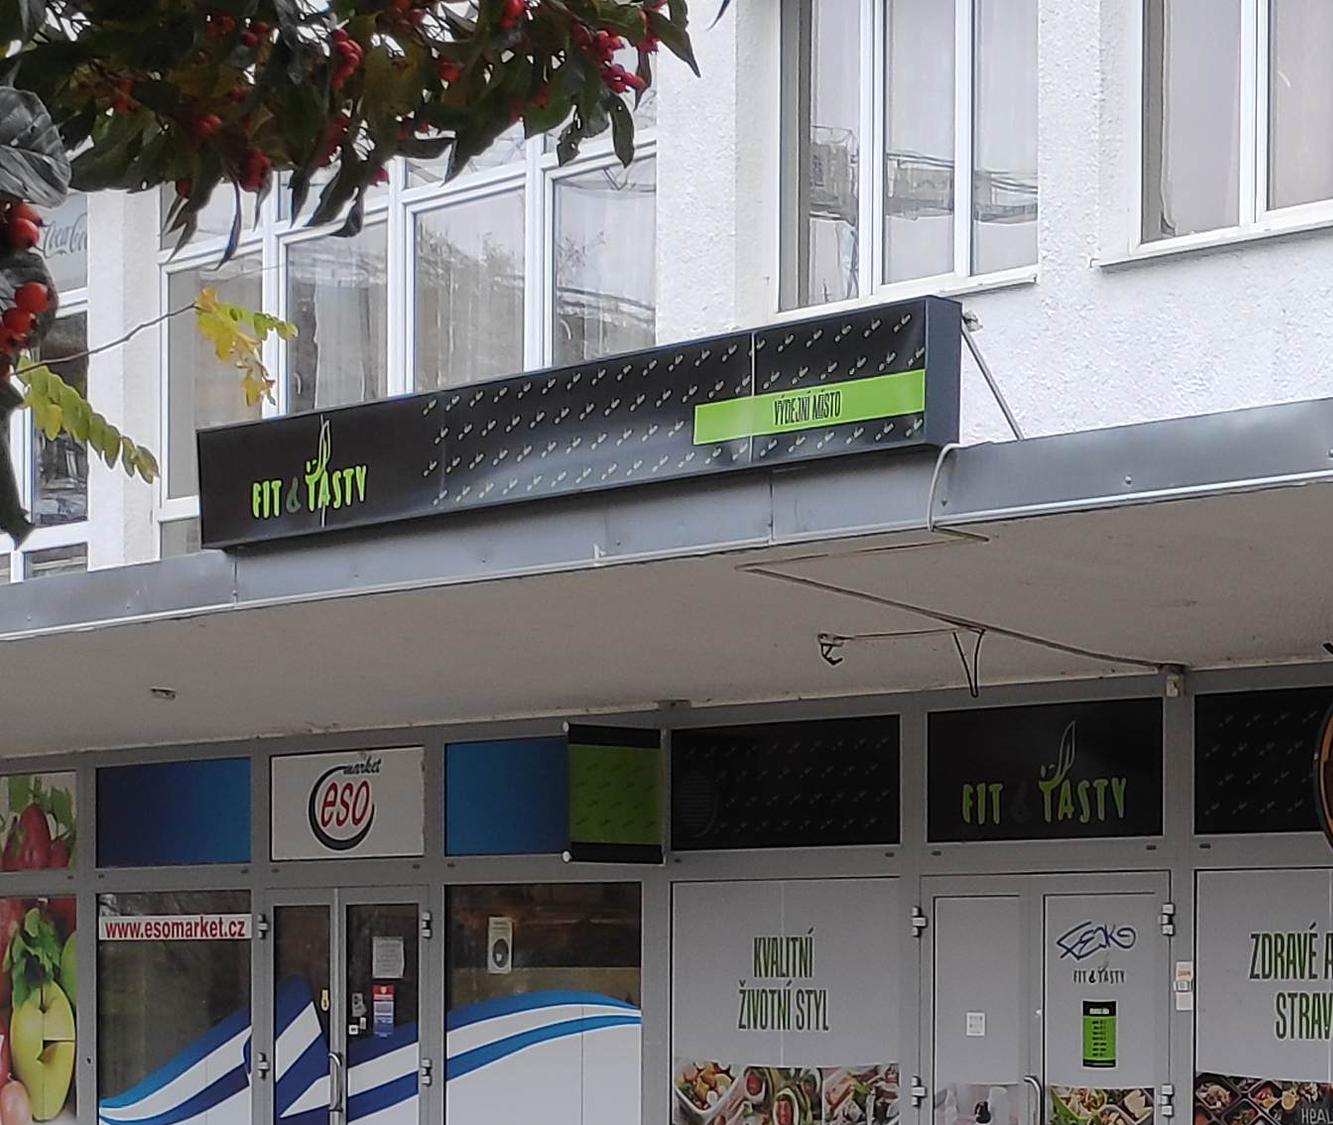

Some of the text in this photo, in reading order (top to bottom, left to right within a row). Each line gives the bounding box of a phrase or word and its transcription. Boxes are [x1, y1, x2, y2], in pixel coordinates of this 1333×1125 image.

[773, 388, 841, 426] VÝDEJNÍ MÍSTO
[252, 480, 282, 518] FIT
[305, 457, 367, 512] TASTY
[343, 756, 382, 774] market
[321, 780, 370, 828] eso
[962, 782, 1003, 825] FIT
[1039, 762, 1127, 824] TASTY
[105, 918, 245, 939] www.esomarket.cz
[753, 927, 814, 978] KVALITNÍ
[1249, 922, 1318, 980] ZDRAVÉ
[1073, 969, 1087, 984] FIT
[1098, 964, 1126, 984] TASTY
[738, 979, 829, 1031] ŽIVOTNÍ STYL
